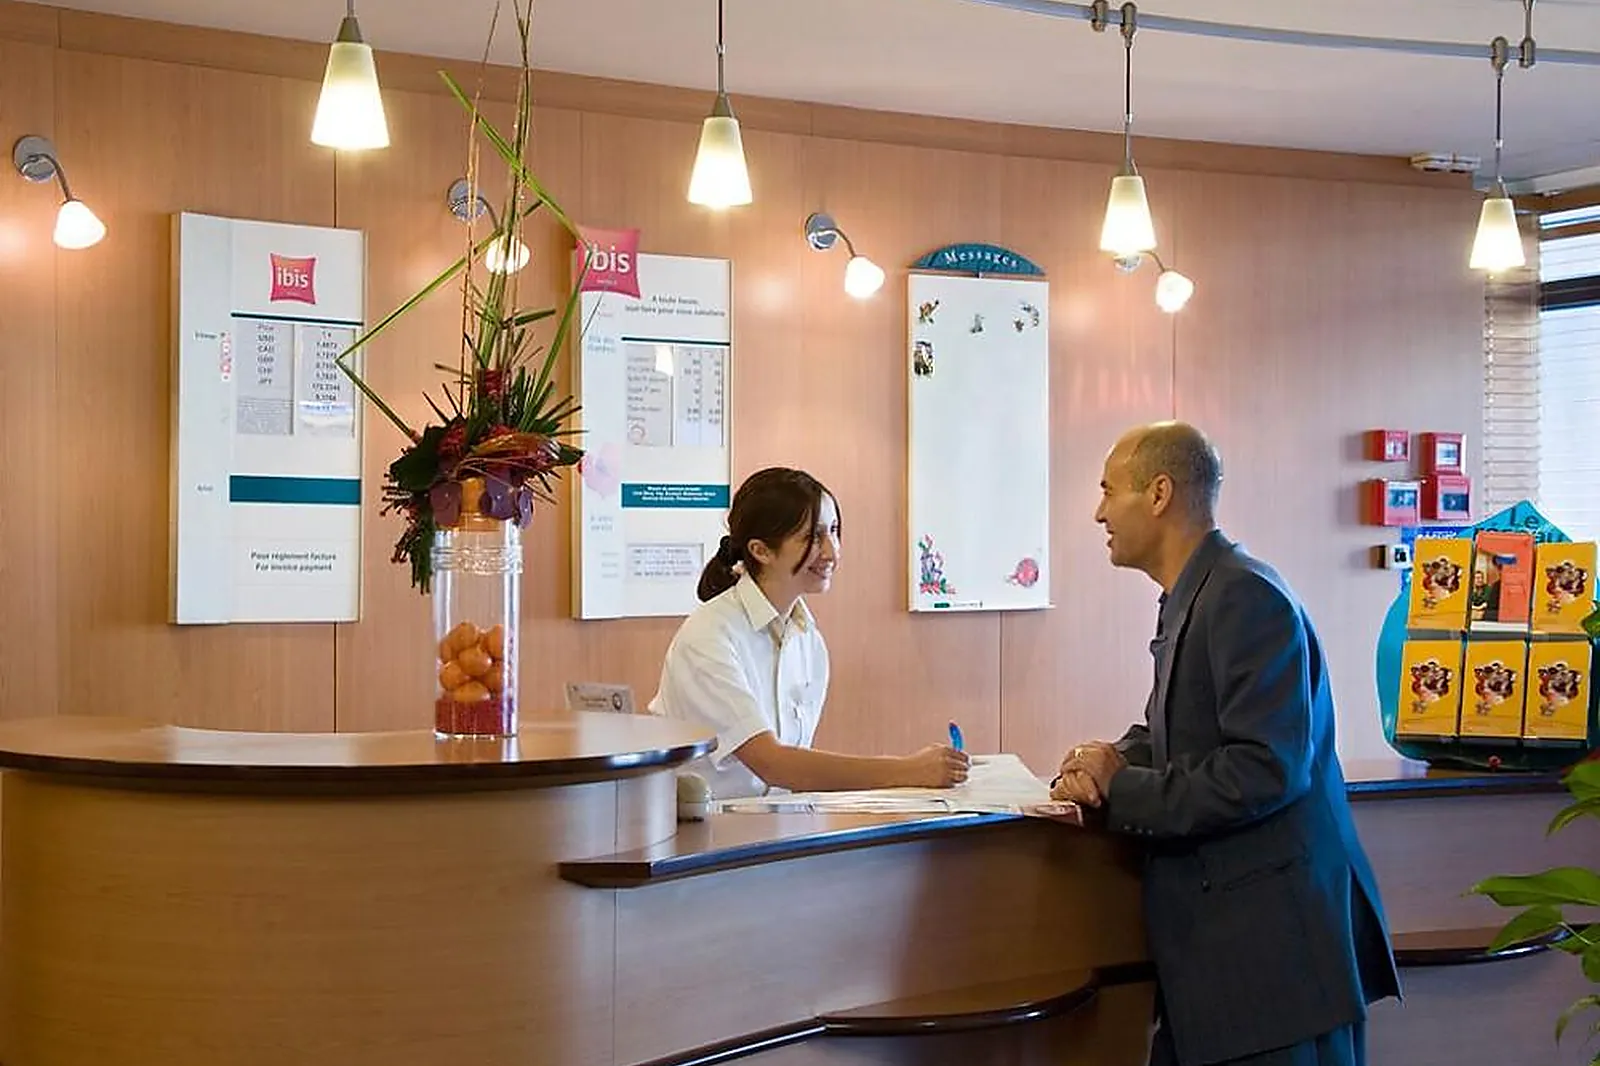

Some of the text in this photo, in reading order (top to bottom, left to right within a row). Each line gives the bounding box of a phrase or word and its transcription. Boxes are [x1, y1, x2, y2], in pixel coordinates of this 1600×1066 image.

[944, 249, 1018, 268] Messages
[276, 267, 309, 288] ibis
[1509, 507, 1539, 530] Le
